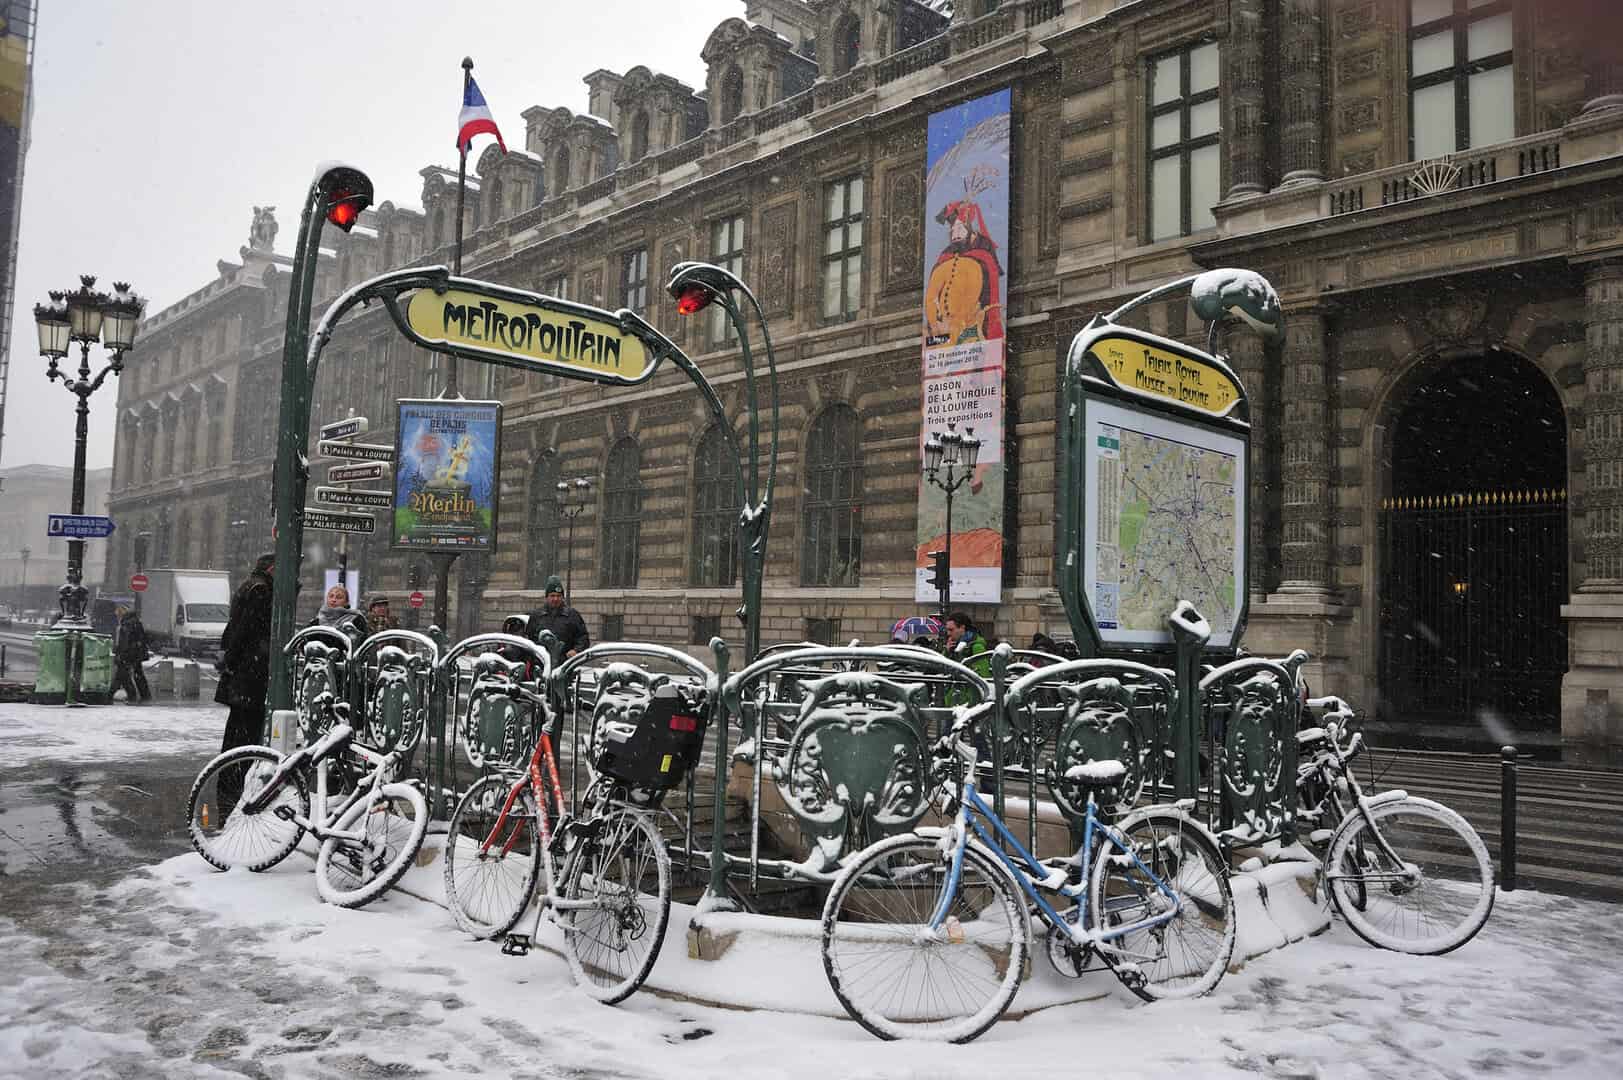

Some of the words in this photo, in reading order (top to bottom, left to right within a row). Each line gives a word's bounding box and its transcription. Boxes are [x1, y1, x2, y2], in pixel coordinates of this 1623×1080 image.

[443, 301, 621, 367] METROPOLITAIN
[928, 381, 961, 393] SAISON
[928, 395, 939, 404] DE
[942, 393, 953, 402] LA
[956, 387, 997, 400] TURQUIE
[928, 406, 940, 415] AU
[943, 401, 979, 413] LOUVRE
[928, 416, 946, 425] Trois
[947, 411, 993, 424] expositions
[410, 492, 476, 513] Merlin
